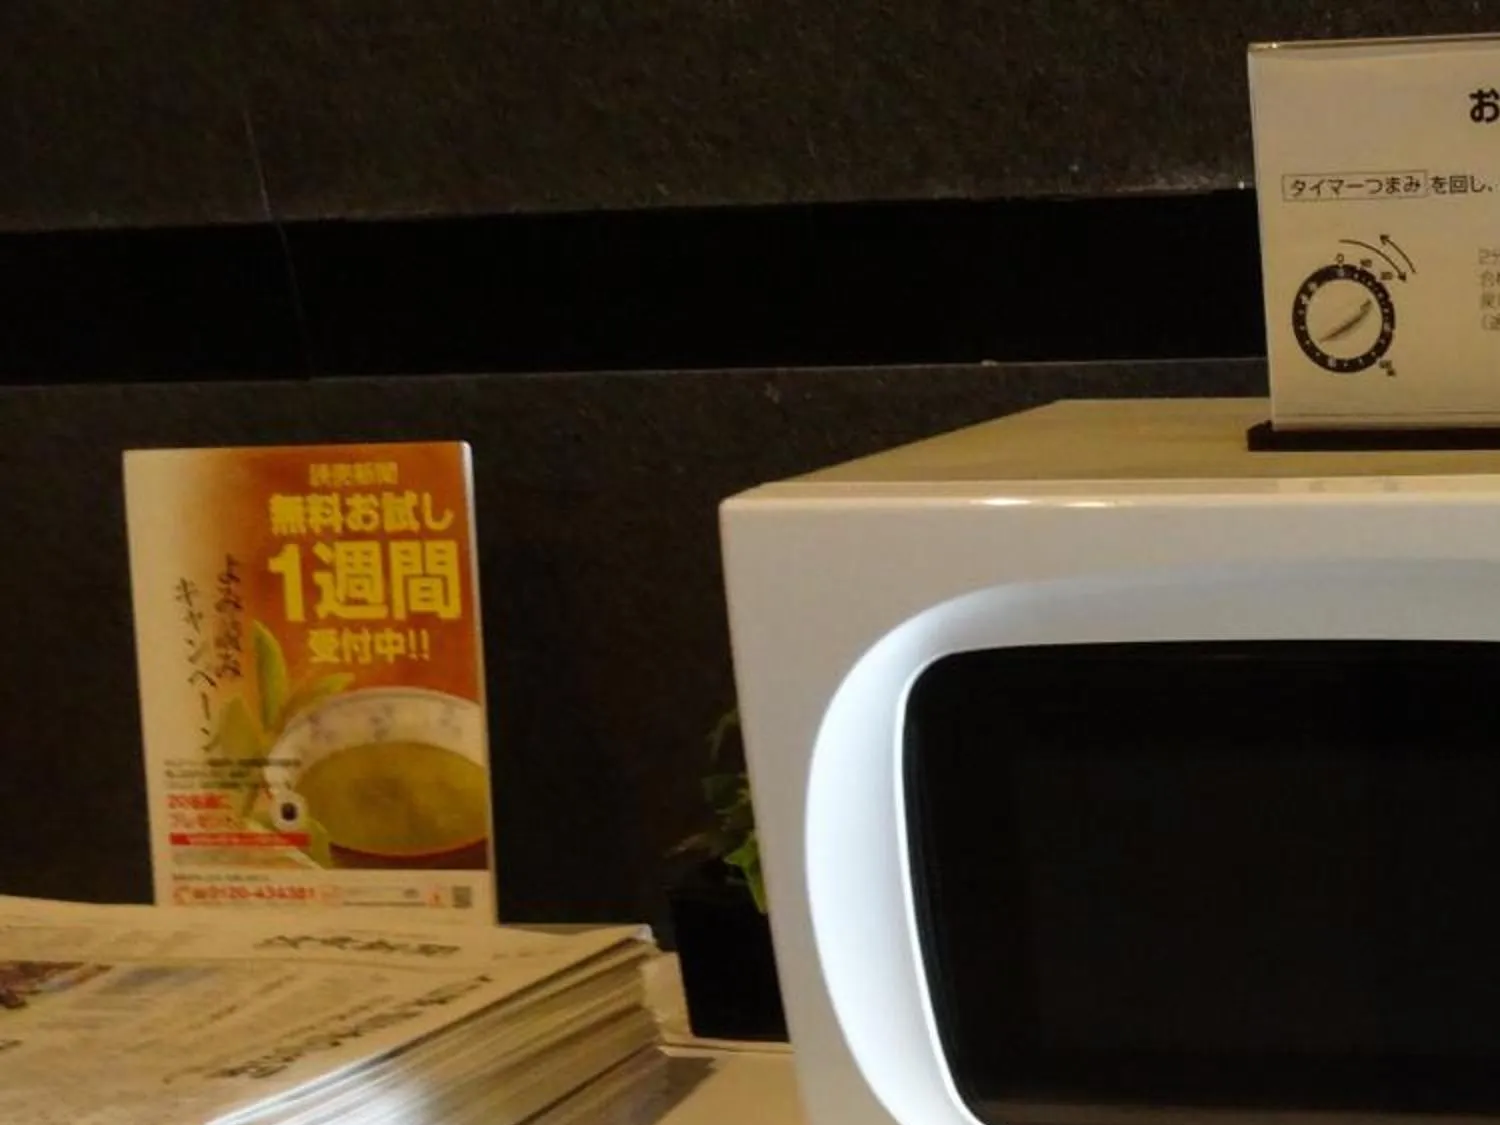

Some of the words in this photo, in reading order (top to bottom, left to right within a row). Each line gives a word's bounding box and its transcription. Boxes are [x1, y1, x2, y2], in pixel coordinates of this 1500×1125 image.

[268, 491, 454, 536] 無料お試し
[268, 540, 462, 623] 1週間
[308, 628, 431, 665] 受付中!!
